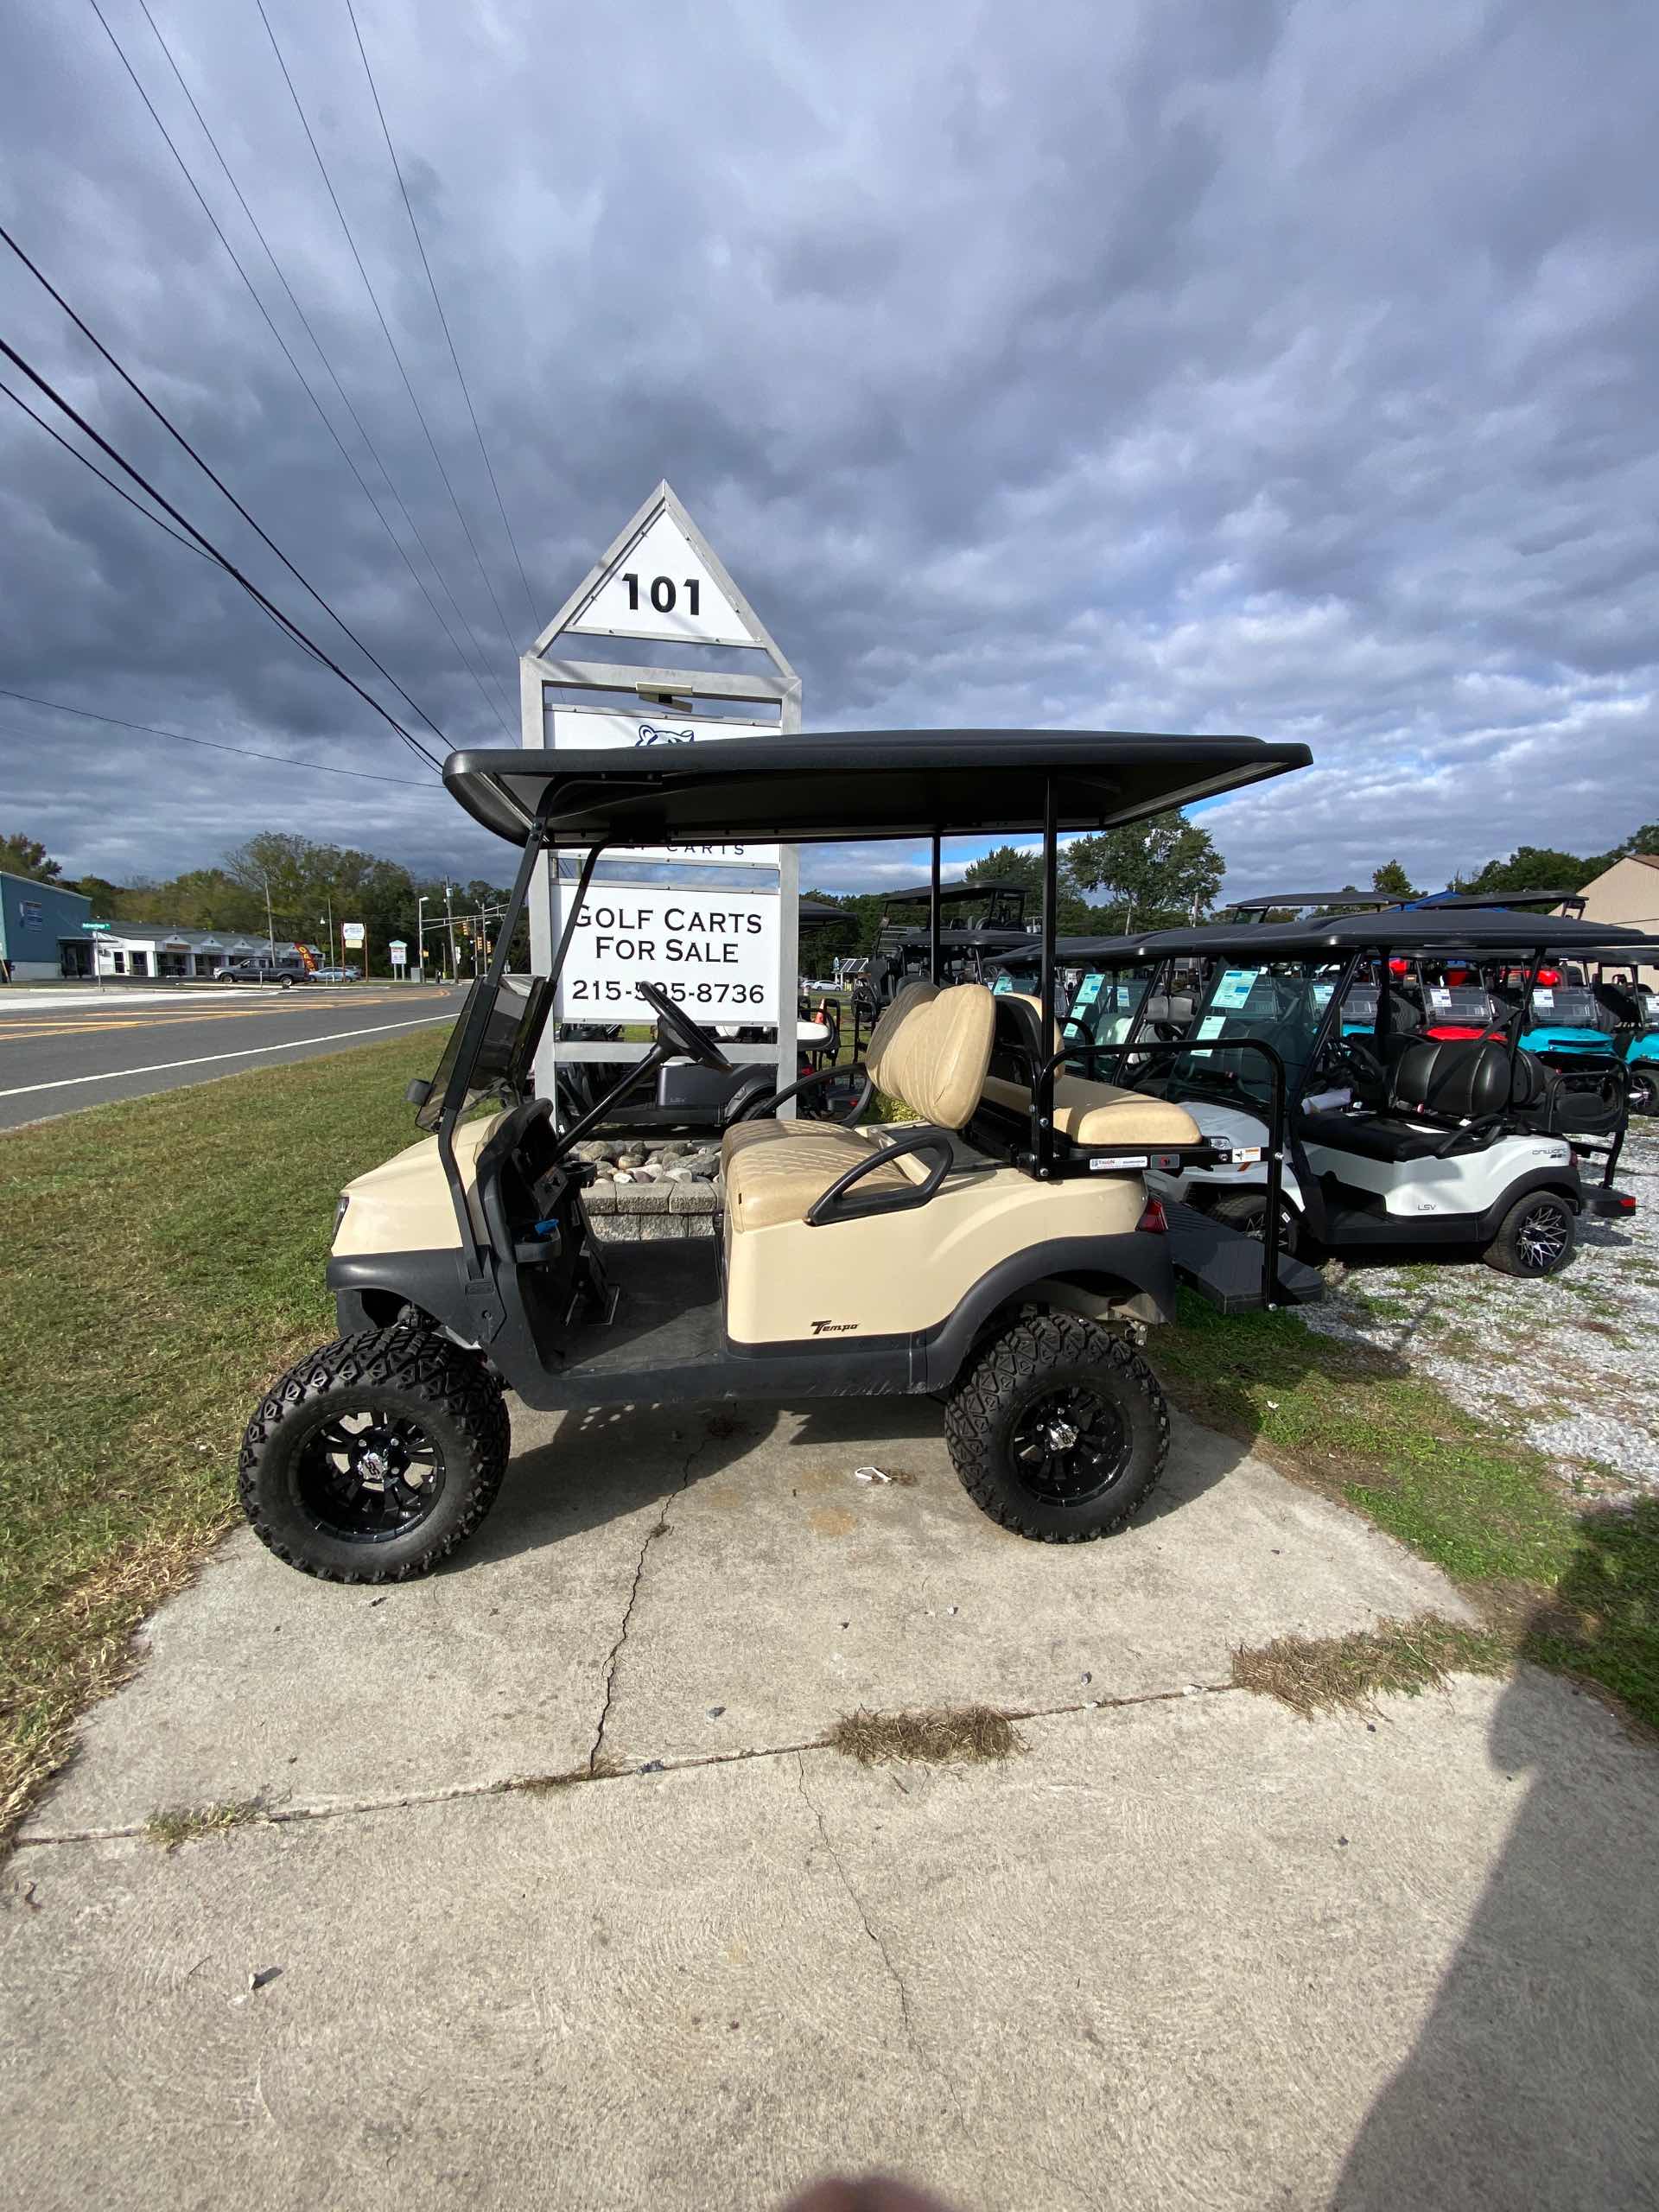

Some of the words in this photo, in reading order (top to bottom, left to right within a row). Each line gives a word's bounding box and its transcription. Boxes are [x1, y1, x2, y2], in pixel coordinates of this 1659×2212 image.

[621, 573, 700, 616] 101
[575, 905, 654, 930] GOLF
[664, 907, 763, 934] CARTS
[595, 936, 656, 961] FOR
[664, 938, 740, 963] SALE
[810, 1319, 859, 1335] Tempo
